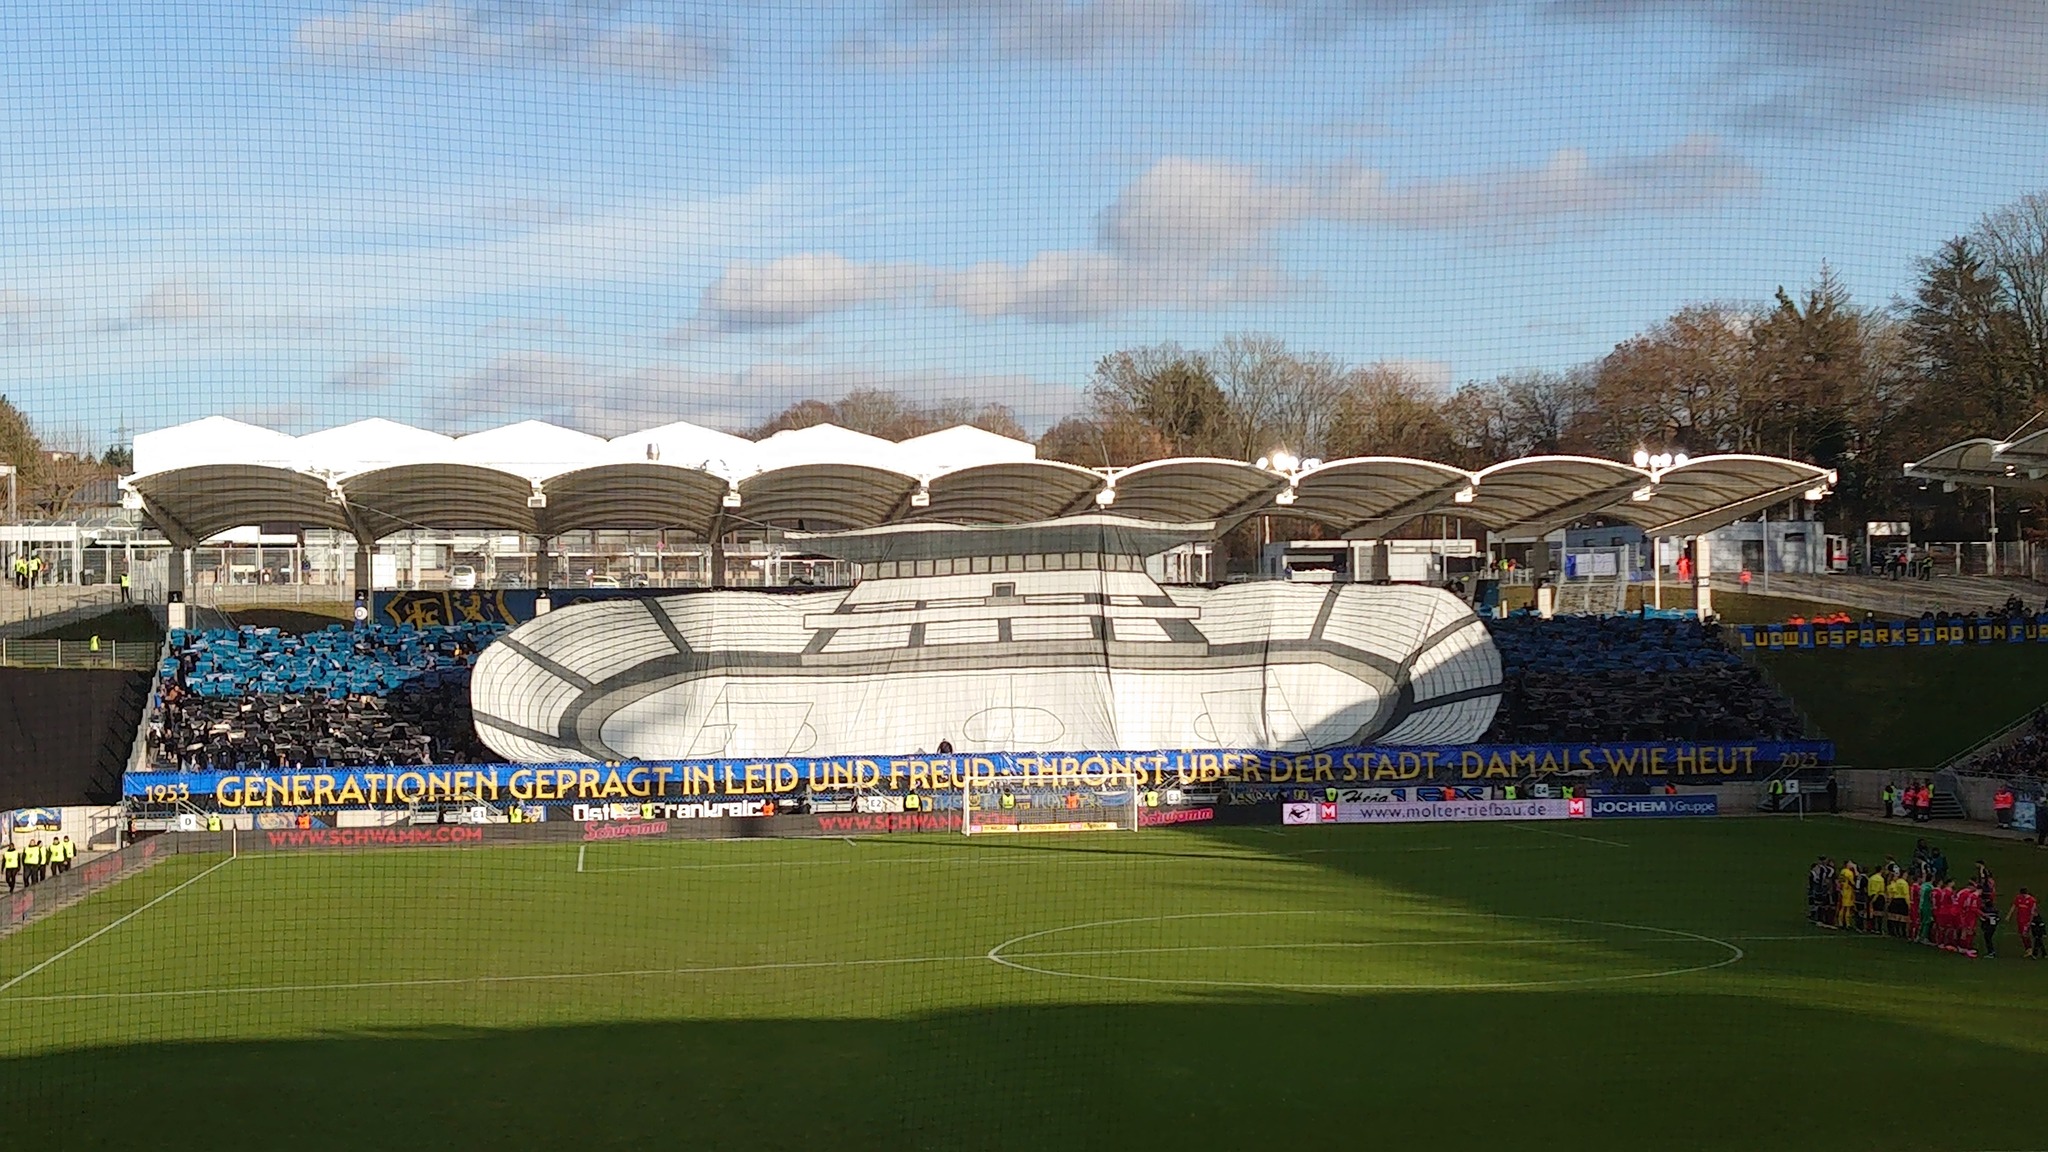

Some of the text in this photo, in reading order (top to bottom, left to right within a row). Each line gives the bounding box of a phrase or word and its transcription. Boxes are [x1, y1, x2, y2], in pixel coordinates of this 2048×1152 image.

[145, 783, 190, 804] 1953
[216, 770, 499, 807] GENERATIONEN
[508, 761, 675, 800] GEPRÄGT
[683, 766, 716, 797] IN
[725, 763, 799, 795] LEID
[809, 760, 880, 793] UND
[889, 757, 995, 790] FREUD
[1018, 755, 1168, 789] THRONST
[1178, 748, 1263, 784] ÜBER
[1270, 754, 1335, 782] DER
[1342, 752, 1440, 781] STADT
[1461, 748, 1595, 779] DAMALS
[1602, 747, 1668, 777] WIE
[1677, 746, 1757, 775] HEUT
[573, 803, 610, 821] Ost
[1138, 807, 1213, 827] Schwamm
[1360, 803, 1547, 819] www.molter-tiefbau.de
[1593, 801, 1716, 815] JOCHEM Gruppe
[267, 826, 483, 846] WWW.SCHWAMM.COM
[583, 820, 667, 840] Schwamm
